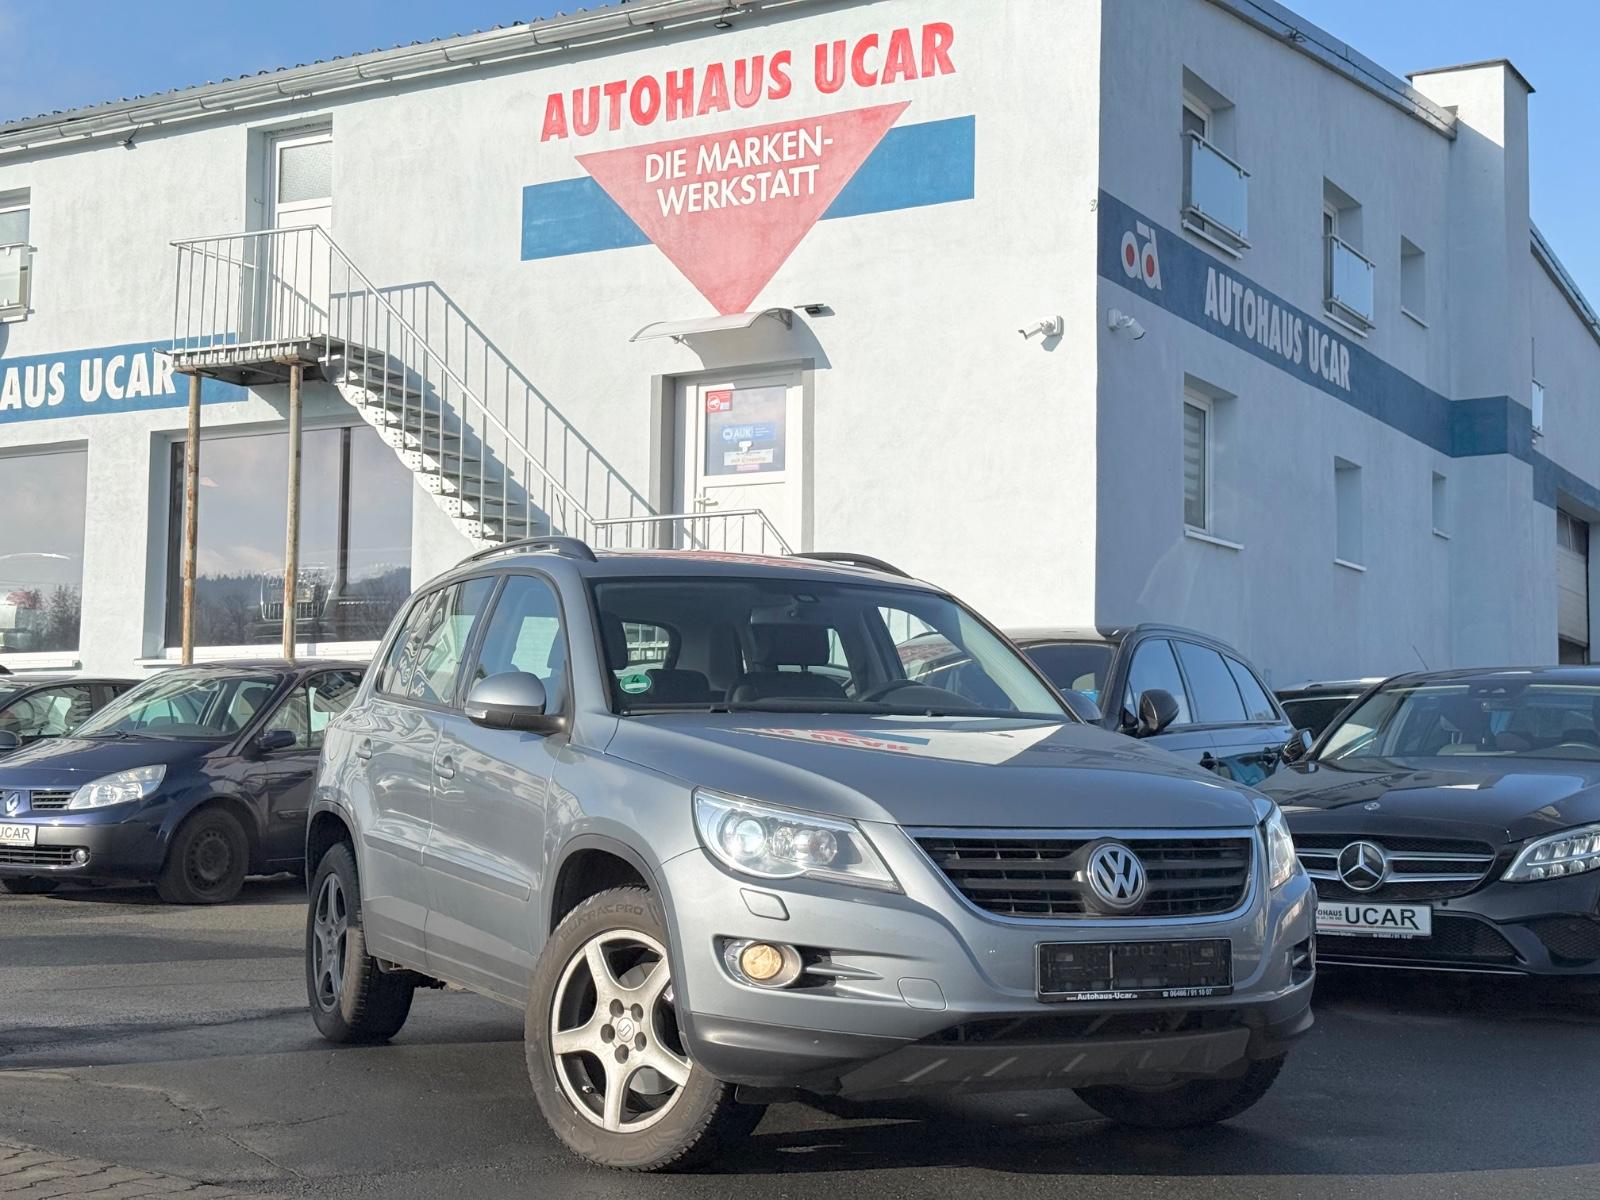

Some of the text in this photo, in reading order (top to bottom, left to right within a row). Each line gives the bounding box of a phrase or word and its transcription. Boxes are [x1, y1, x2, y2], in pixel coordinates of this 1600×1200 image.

[541, 22, 956, 142] AUTOHAUS UCAR
[645, 125, 833, 183] DIE MARKEN-
[656, 164, 820, 217] WERKSTATT
[1204, 266, 1351, 392] AUTOHAUS UCAR
[80, 352, 176, 403] UCAR
[1090, 846, 1142, 904] VW
[1345, 906, 1420, 930] UCAR
